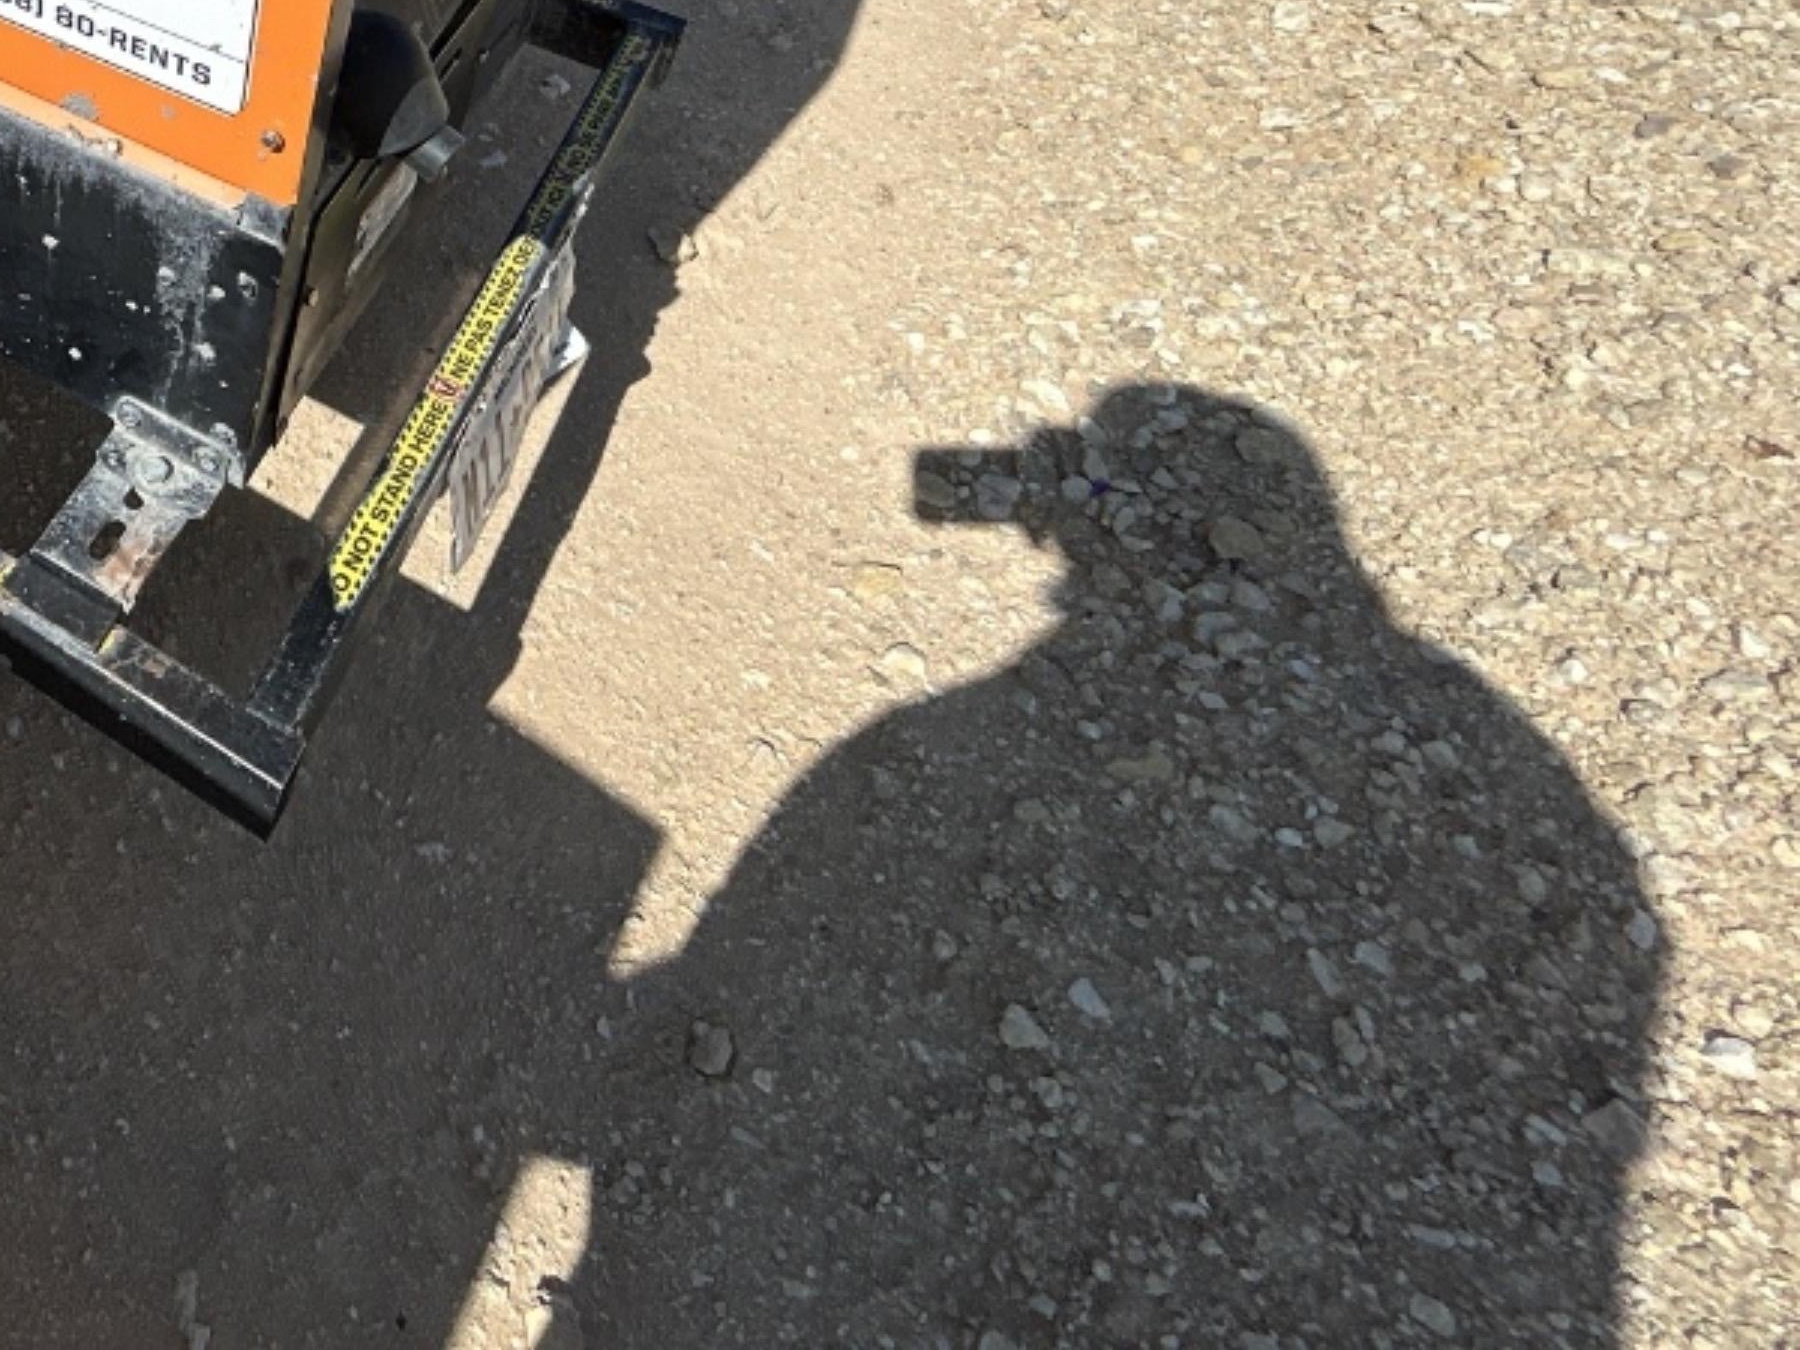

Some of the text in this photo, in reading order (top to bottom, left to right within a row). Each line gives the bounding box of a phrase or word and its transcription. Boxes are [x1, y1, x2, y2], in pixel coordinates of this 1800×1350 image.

[55, 3, 213, 86] 80-RENTS
[342, 521, 380, 573] NOT
[371, 455, 419, 523] STAND
[408, 401, 449, 453] HERE
